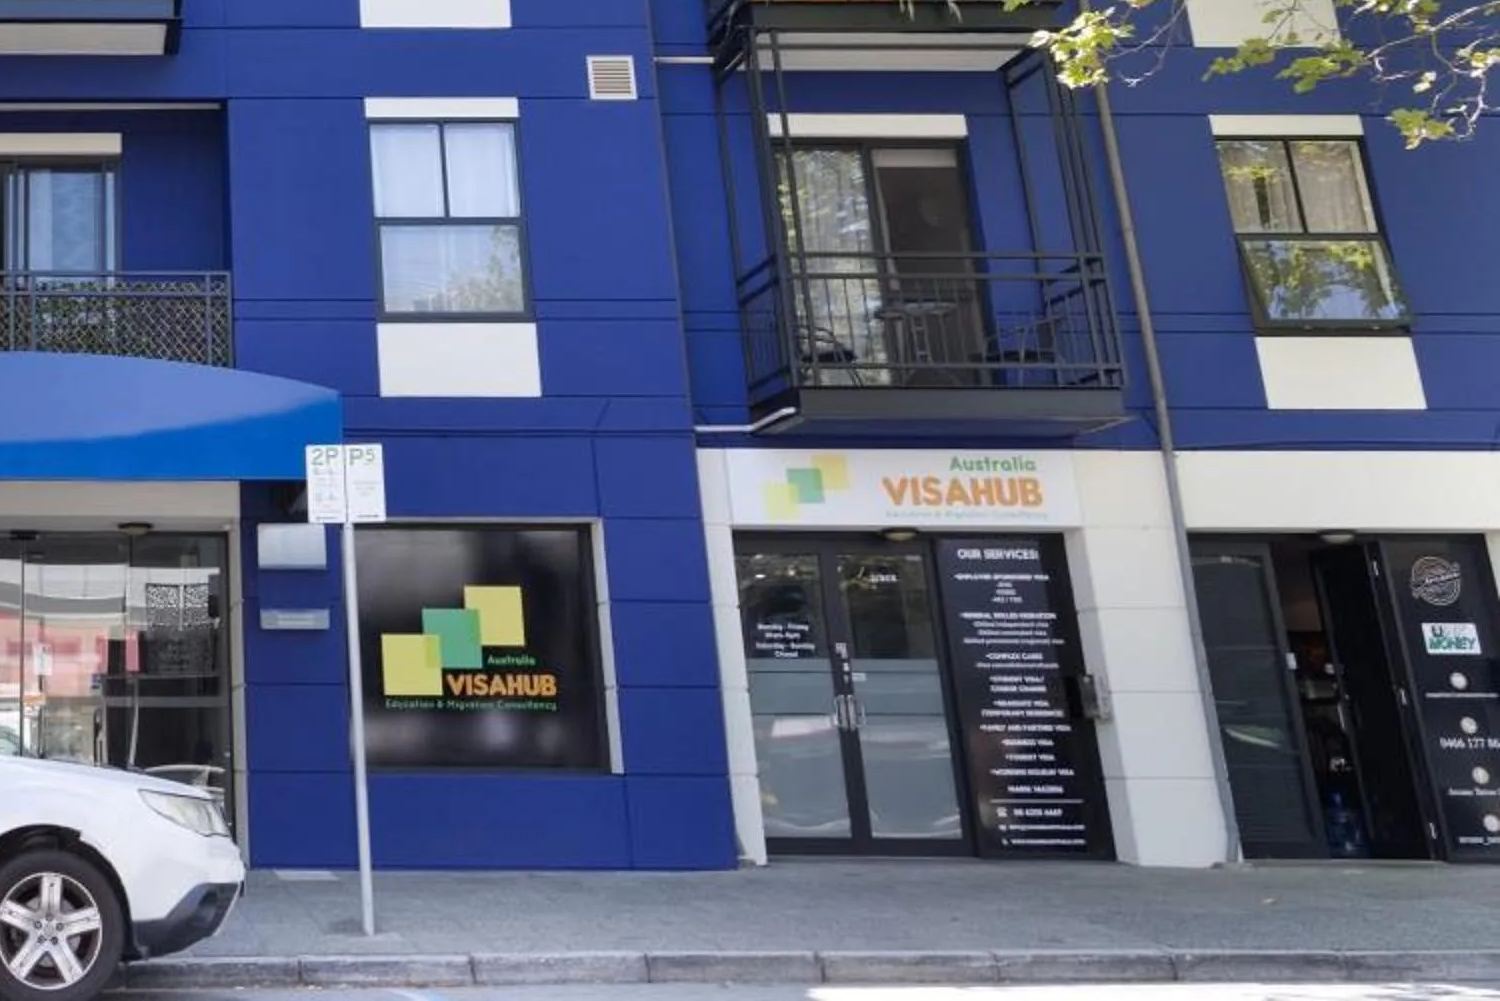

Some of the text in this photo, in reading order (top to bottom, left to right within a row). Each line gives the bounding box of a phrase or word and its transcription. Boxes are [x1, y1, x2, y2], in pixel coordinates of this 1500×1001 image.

[311, 447, 339, 466] 2P
[949, 456, 1037, 472] Australia
[882, 476, 1044, 508] VISAHUB
[1429, 637, 1476, 649] MONEY
[487, 654, 536, 666] Australia
[447, 674, 557, 696] VISAHUB
